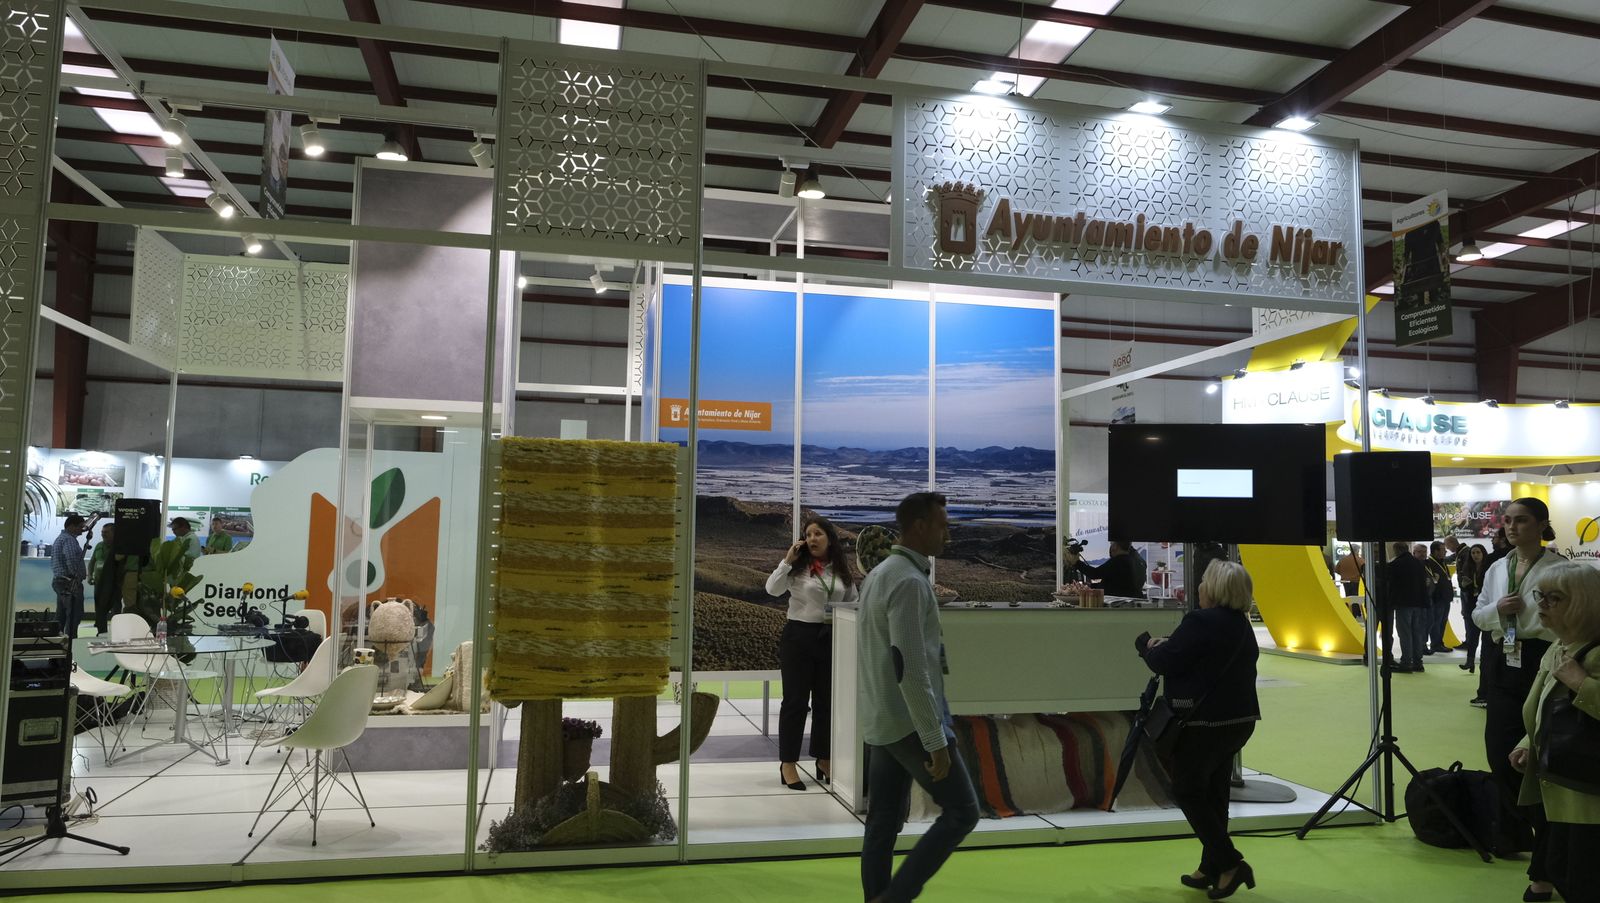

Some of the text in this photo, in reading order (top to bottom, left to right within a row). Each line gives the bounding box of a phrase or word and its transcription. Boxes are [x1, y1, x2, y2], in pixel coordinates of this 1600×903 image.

[986, 198, 1343, 274] Ayuntamiento de Níjar
[1400, 303, 1447, 321] Comprometidos
[1409, 315, 1438, 328] Eficientes
[1112, 354, 1132, 369] AGRO
[1267, 386, 1331, 407] CLAUSE
[683, 407, 732, 418] Antamiento
[733, 409, 743, 418] de
[1372, 408, 1469, 435] CLAUSE
[1433, 511, 1492, 520] HM CLAUSE
[204, 582, 289, 600] Diamond
